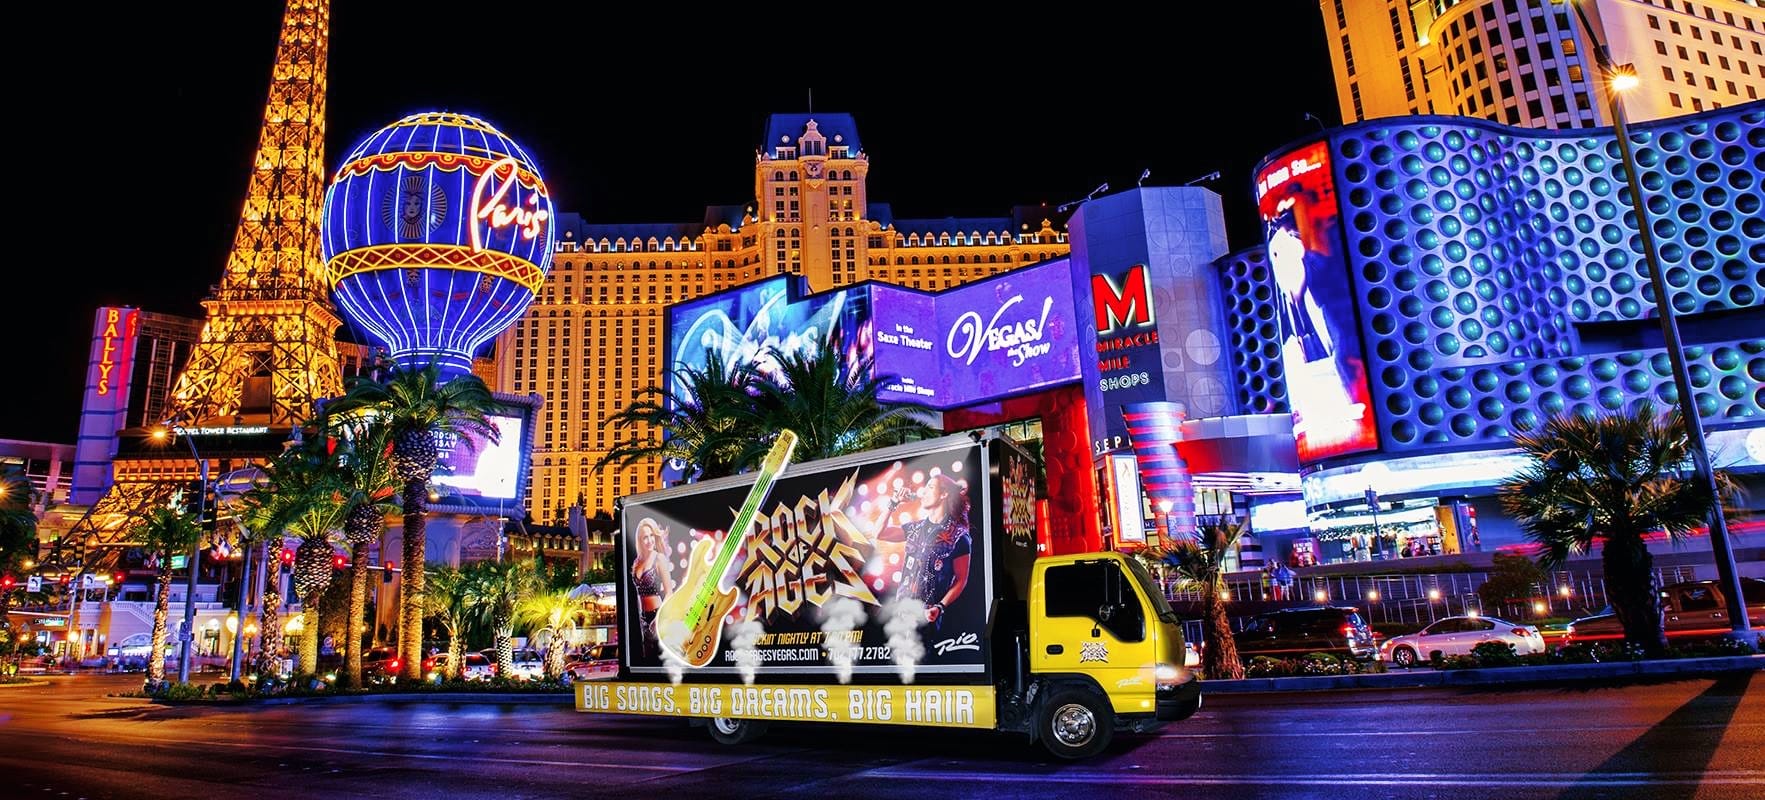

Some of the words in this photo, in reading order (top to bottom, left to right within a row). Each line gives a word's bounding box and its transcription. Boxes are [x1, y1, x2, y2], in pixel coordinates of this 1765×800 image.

[470, 157, 548, 253] Paris
[1091, 264, 1154, 335] M
[98, 309, 119, 394] BALLYS
[900, 335, 933, 350] Theater
[1013, 342, 1051, 367] Show
[1097, 330, 1158, 353] MIRACLE
[1098, 355, 1130, 373] MILE
[1100, 372, 1150, 391] SHOPS
[729, 466, 870, 580] ROCK
[744, 542, 882, 621] AGES
[777, 632, 809, 645] NIGHTLY
[810, 632, 821, 644] AT
[583, 685, 609, 710] BIG
[616, 685, 681, 714] SONGS,
[689, 687, 722, 715] BIG
[730, 687, 838, 720] DREAMS,
[848, 688, 892, 721] BIG
[904, 689, 975, 724] HAIR
